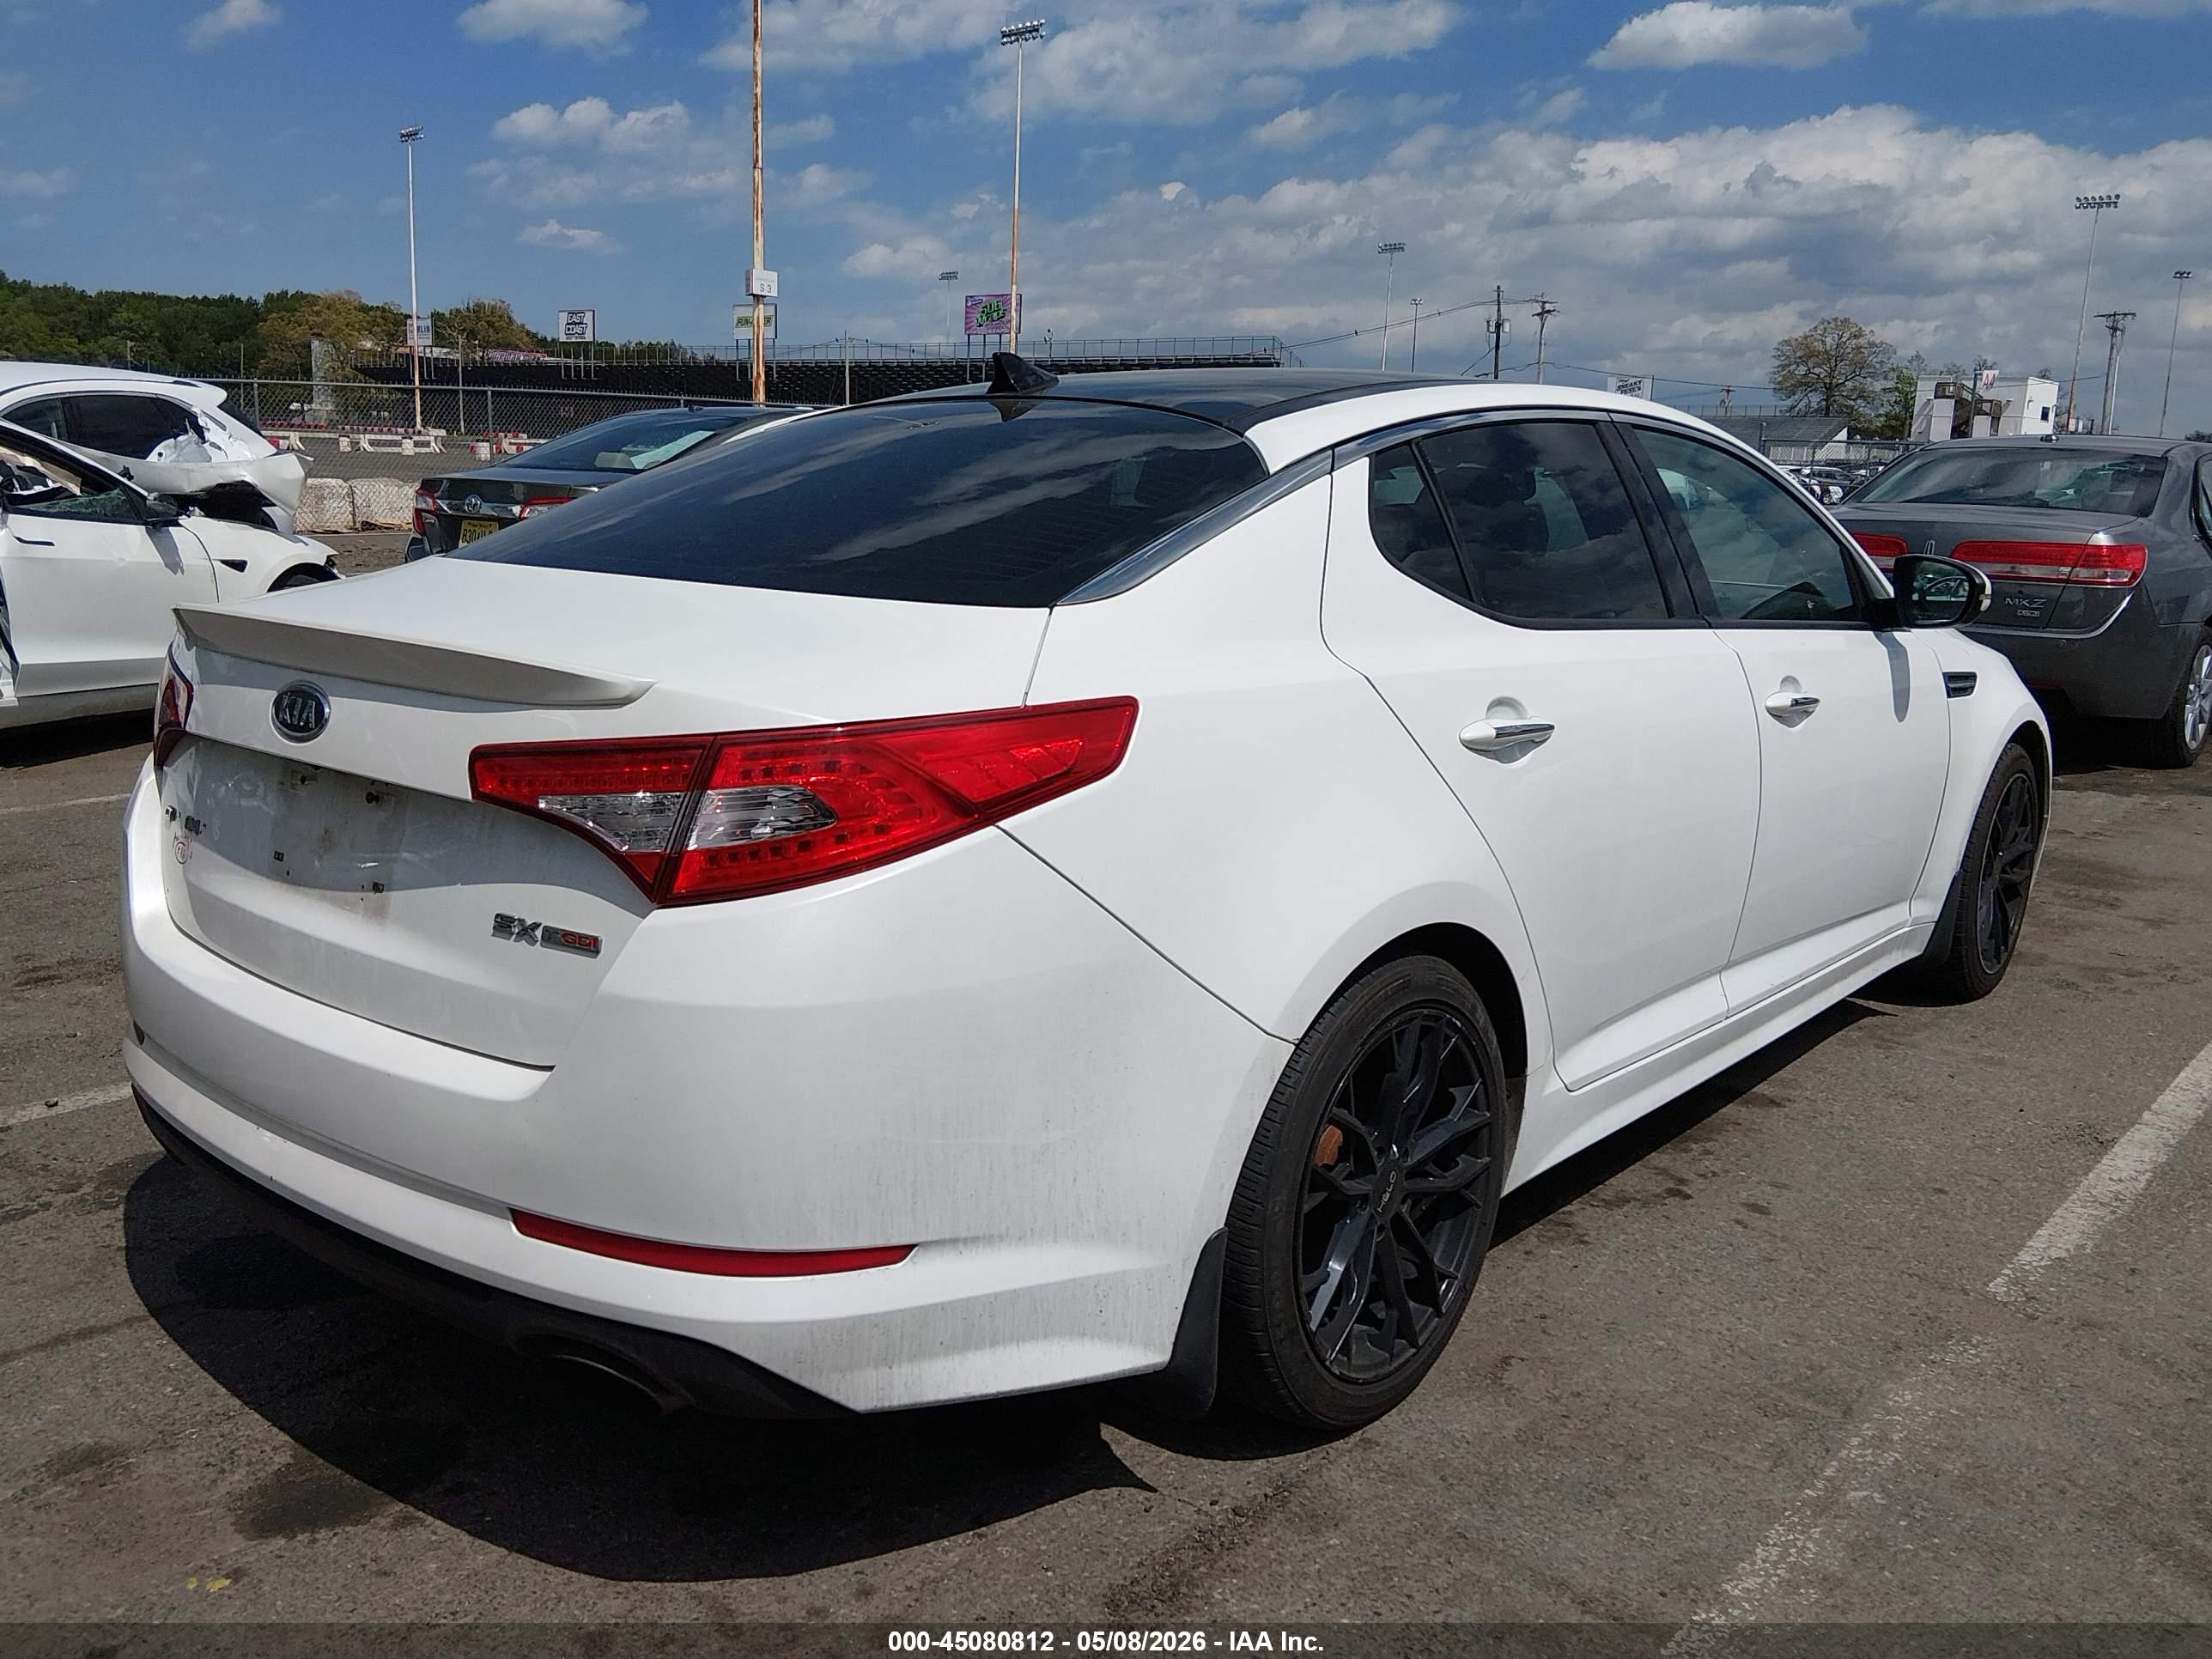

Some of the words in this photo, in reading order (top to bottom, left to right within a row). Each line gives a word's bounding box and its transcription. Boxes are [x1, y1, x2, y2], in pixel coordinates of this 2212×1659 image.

[567, 312, 586, 324] EAST
[2004, 598, 2047, 608] MKZ
[278, 692, 316, 729] KIA
[491, 913, 543, 946] SX
[1376, 1170, 1397, 1212] HELO
